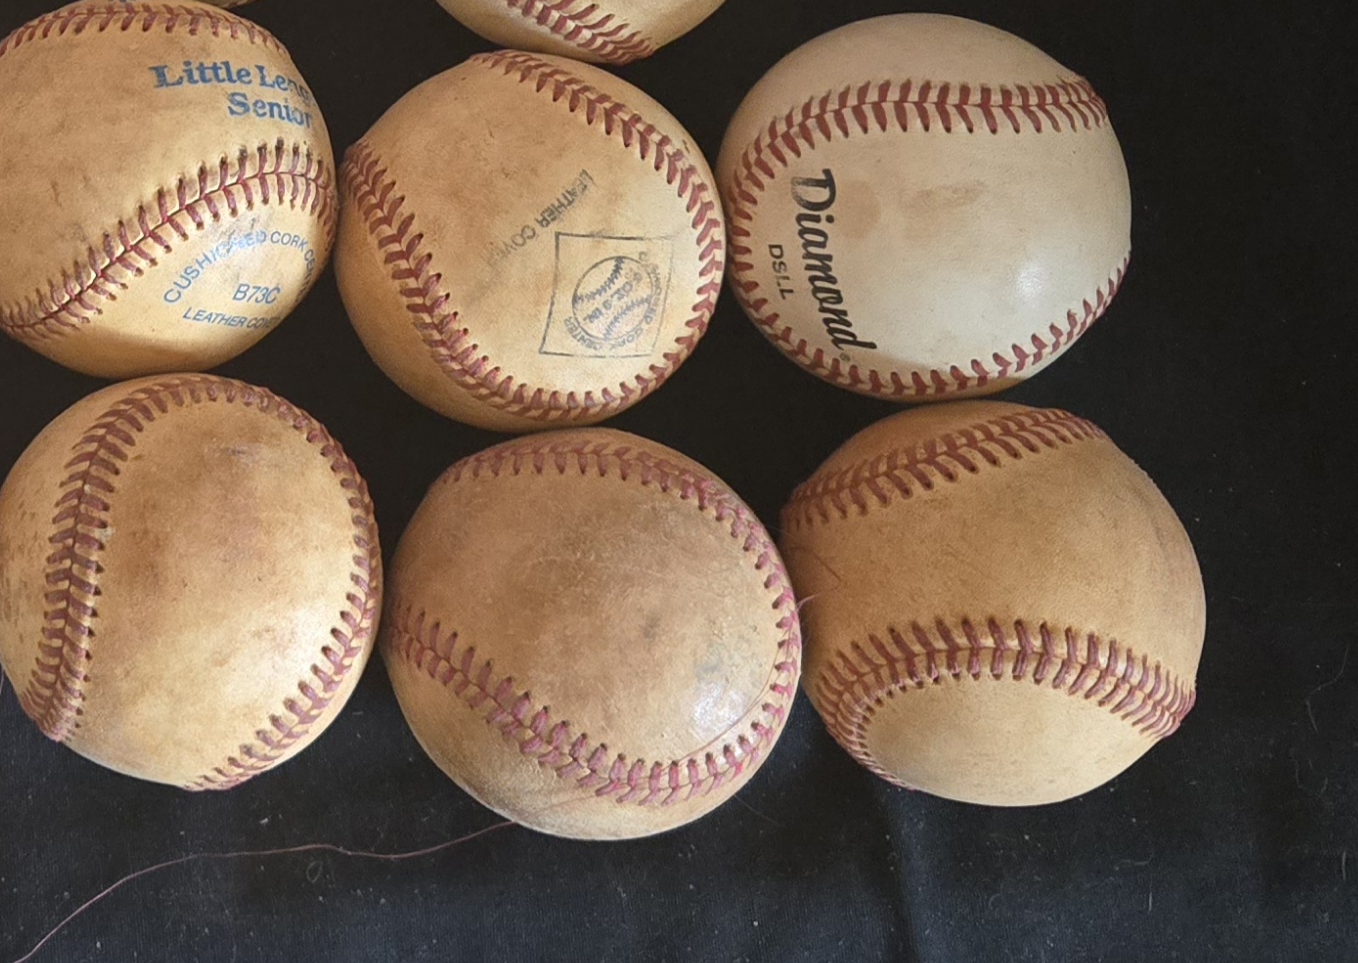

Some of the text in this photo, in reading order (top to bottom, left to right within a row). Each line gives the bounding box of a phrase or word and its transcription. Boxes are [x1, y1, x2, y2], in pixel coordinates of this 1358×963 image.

[148, 60, 253, 89] Little
[226, 91, 314, 131] Senior
[539, 168, 594, 233] LEATHER
[270, 230, 308, 253] CORK
[790, 167, 878, 352] Diamond
[182, 306, 246, 328] LEATHER
